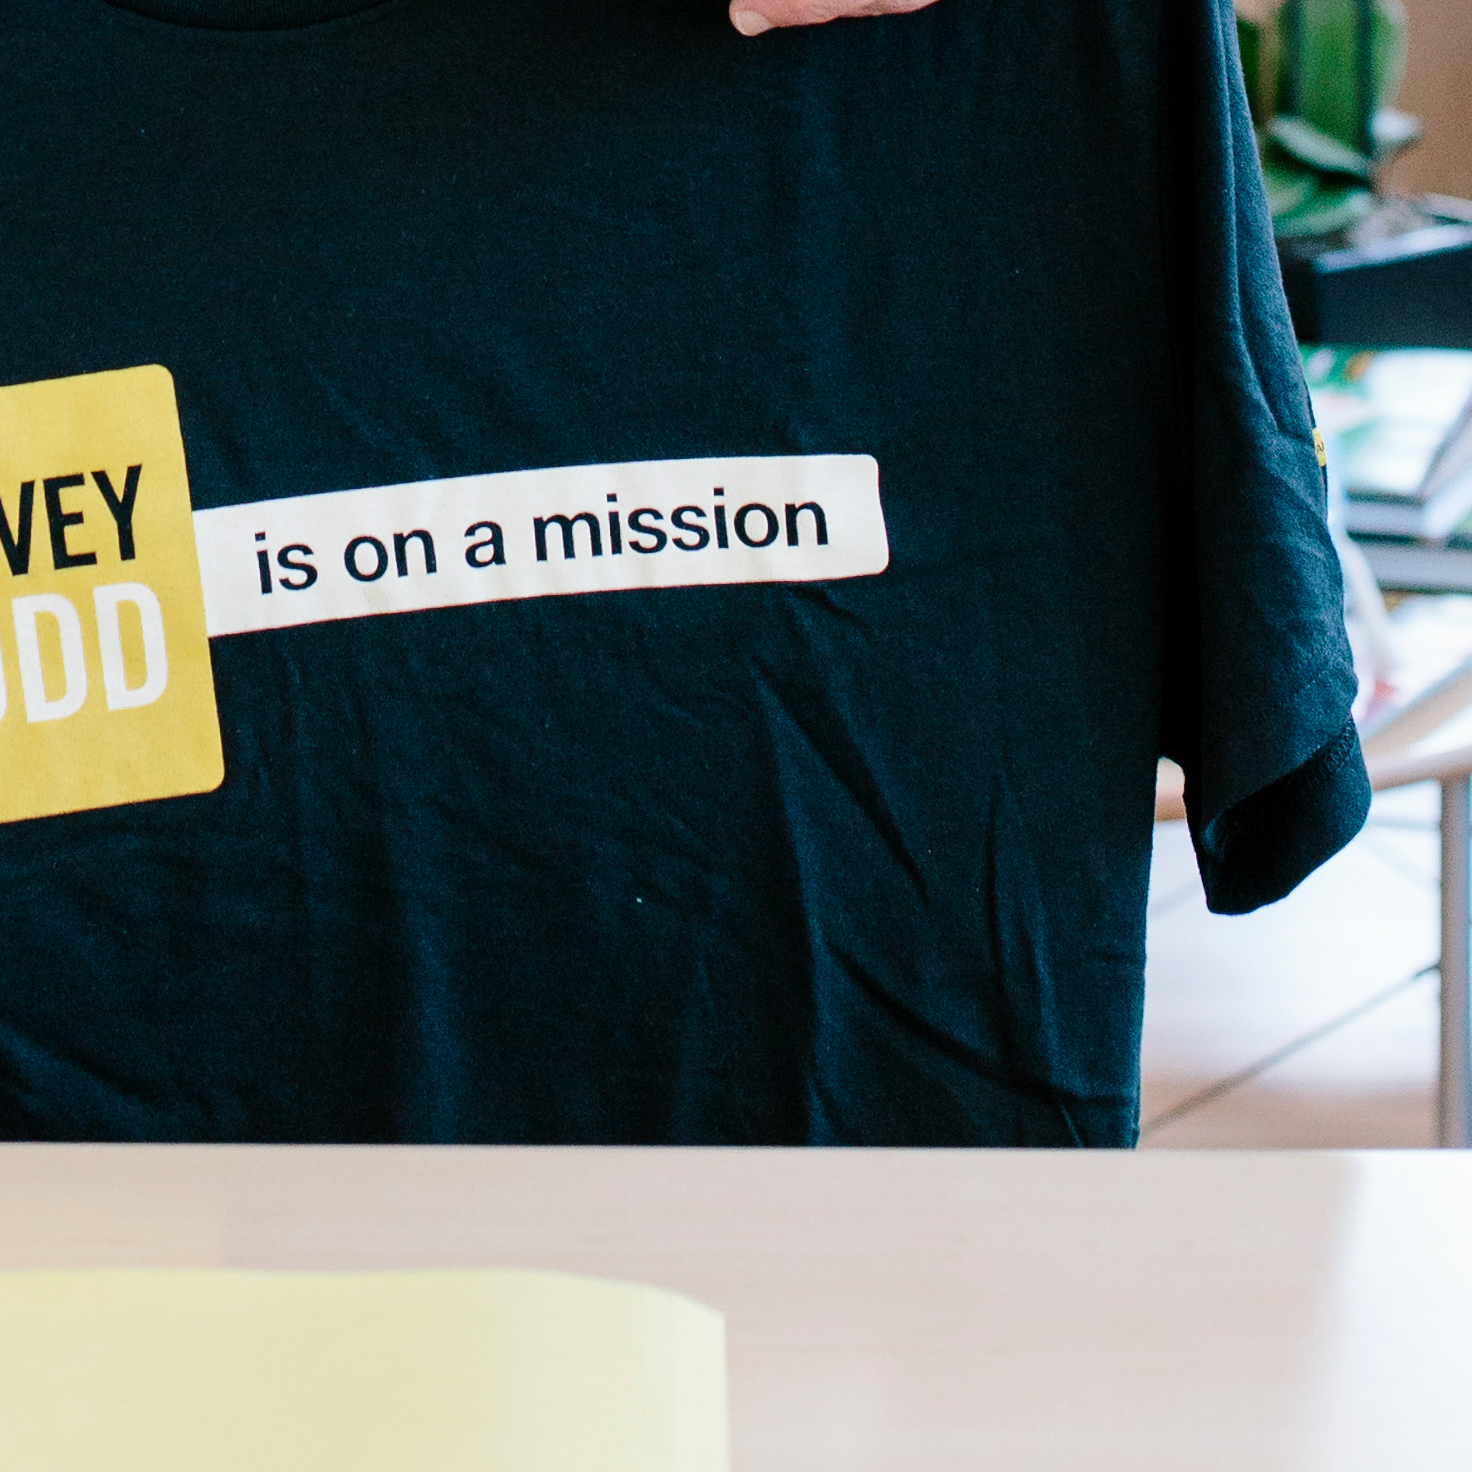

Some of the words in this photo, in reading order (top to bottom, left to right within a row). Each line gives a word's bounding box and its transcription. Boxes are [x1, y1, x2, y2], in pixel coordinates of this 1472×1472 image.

[254, 531, 319, 596] is
[343, 528, 437, 584] on
[463, 521, 508, 570] a
[532, 487, 830, 563] mission
